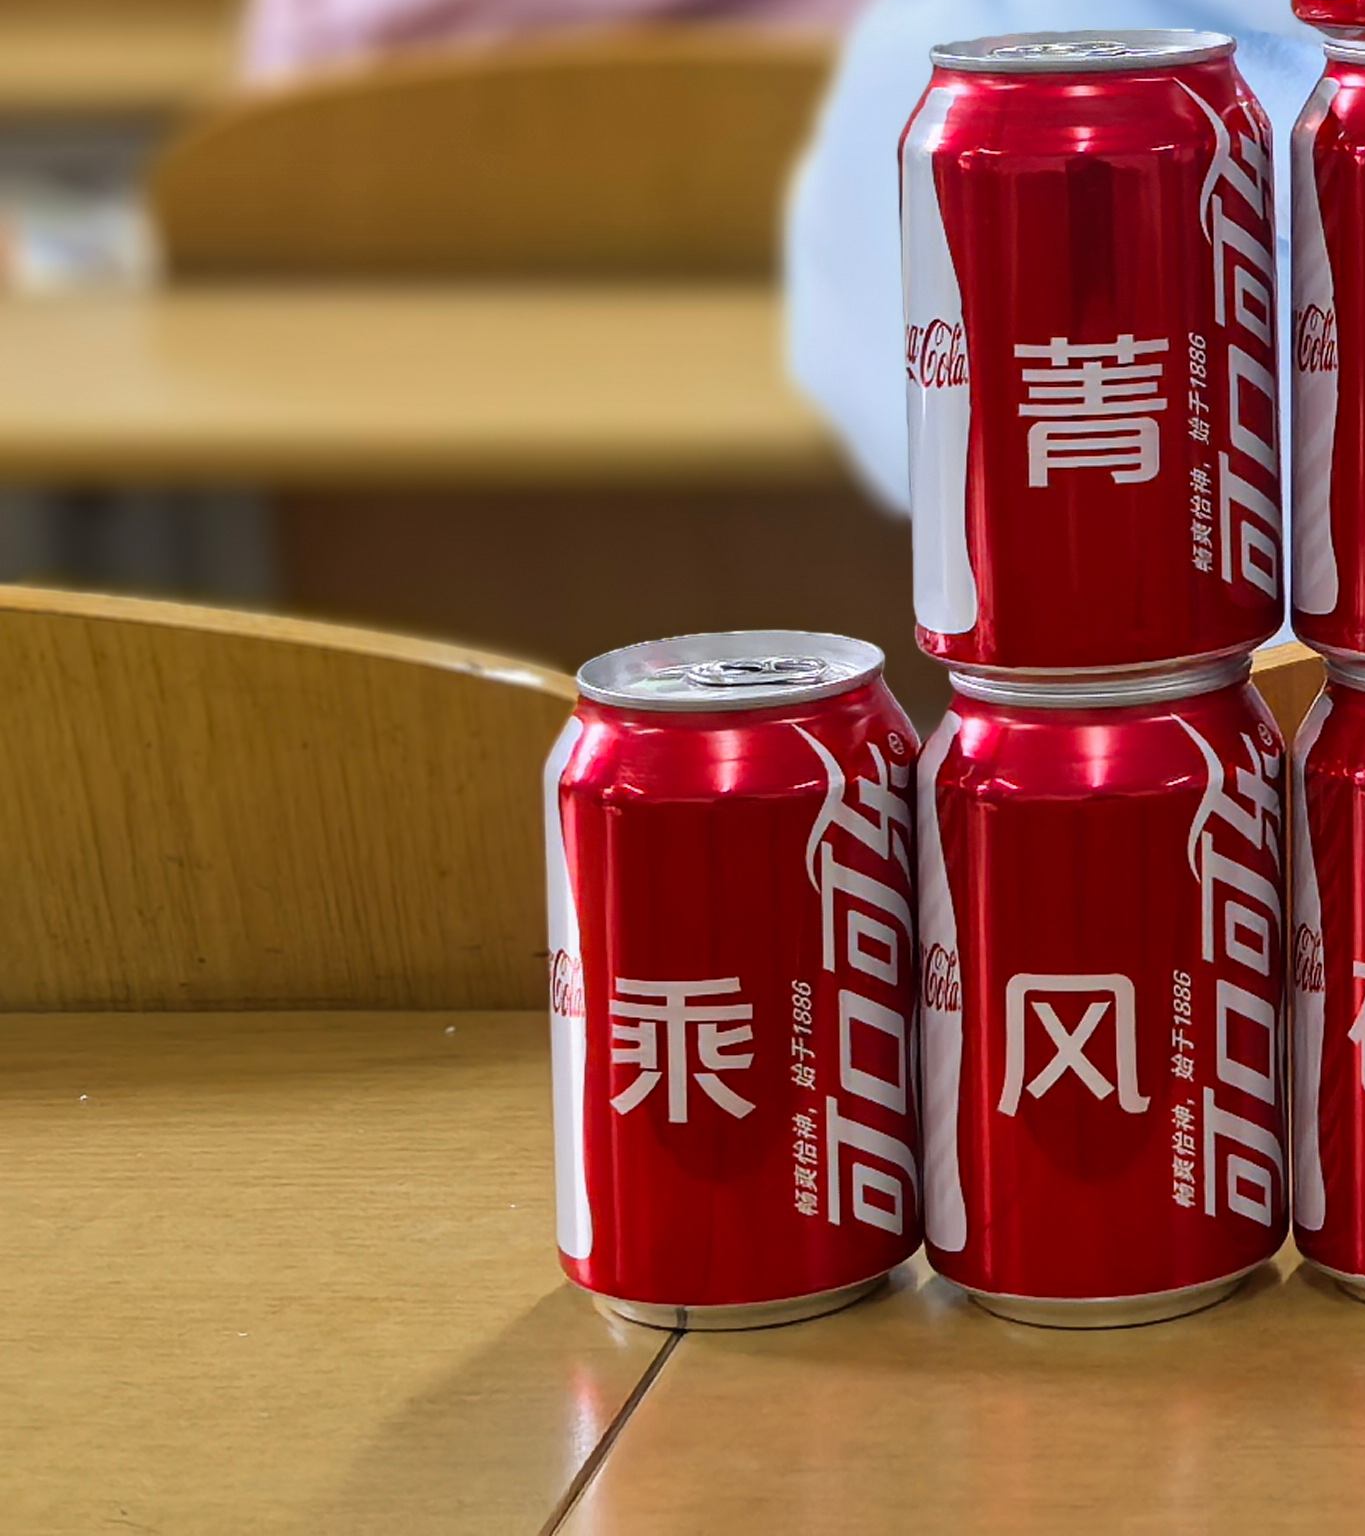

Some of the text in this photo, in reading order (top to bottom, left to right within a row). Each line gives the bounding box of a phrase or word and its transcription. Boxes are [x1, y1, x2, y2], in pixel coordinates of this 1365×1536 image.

[1014, 334, 1169, 487] 菁
[608, 977, 756, 1123] 乘
[997, 973, 1151, 1117] 风
